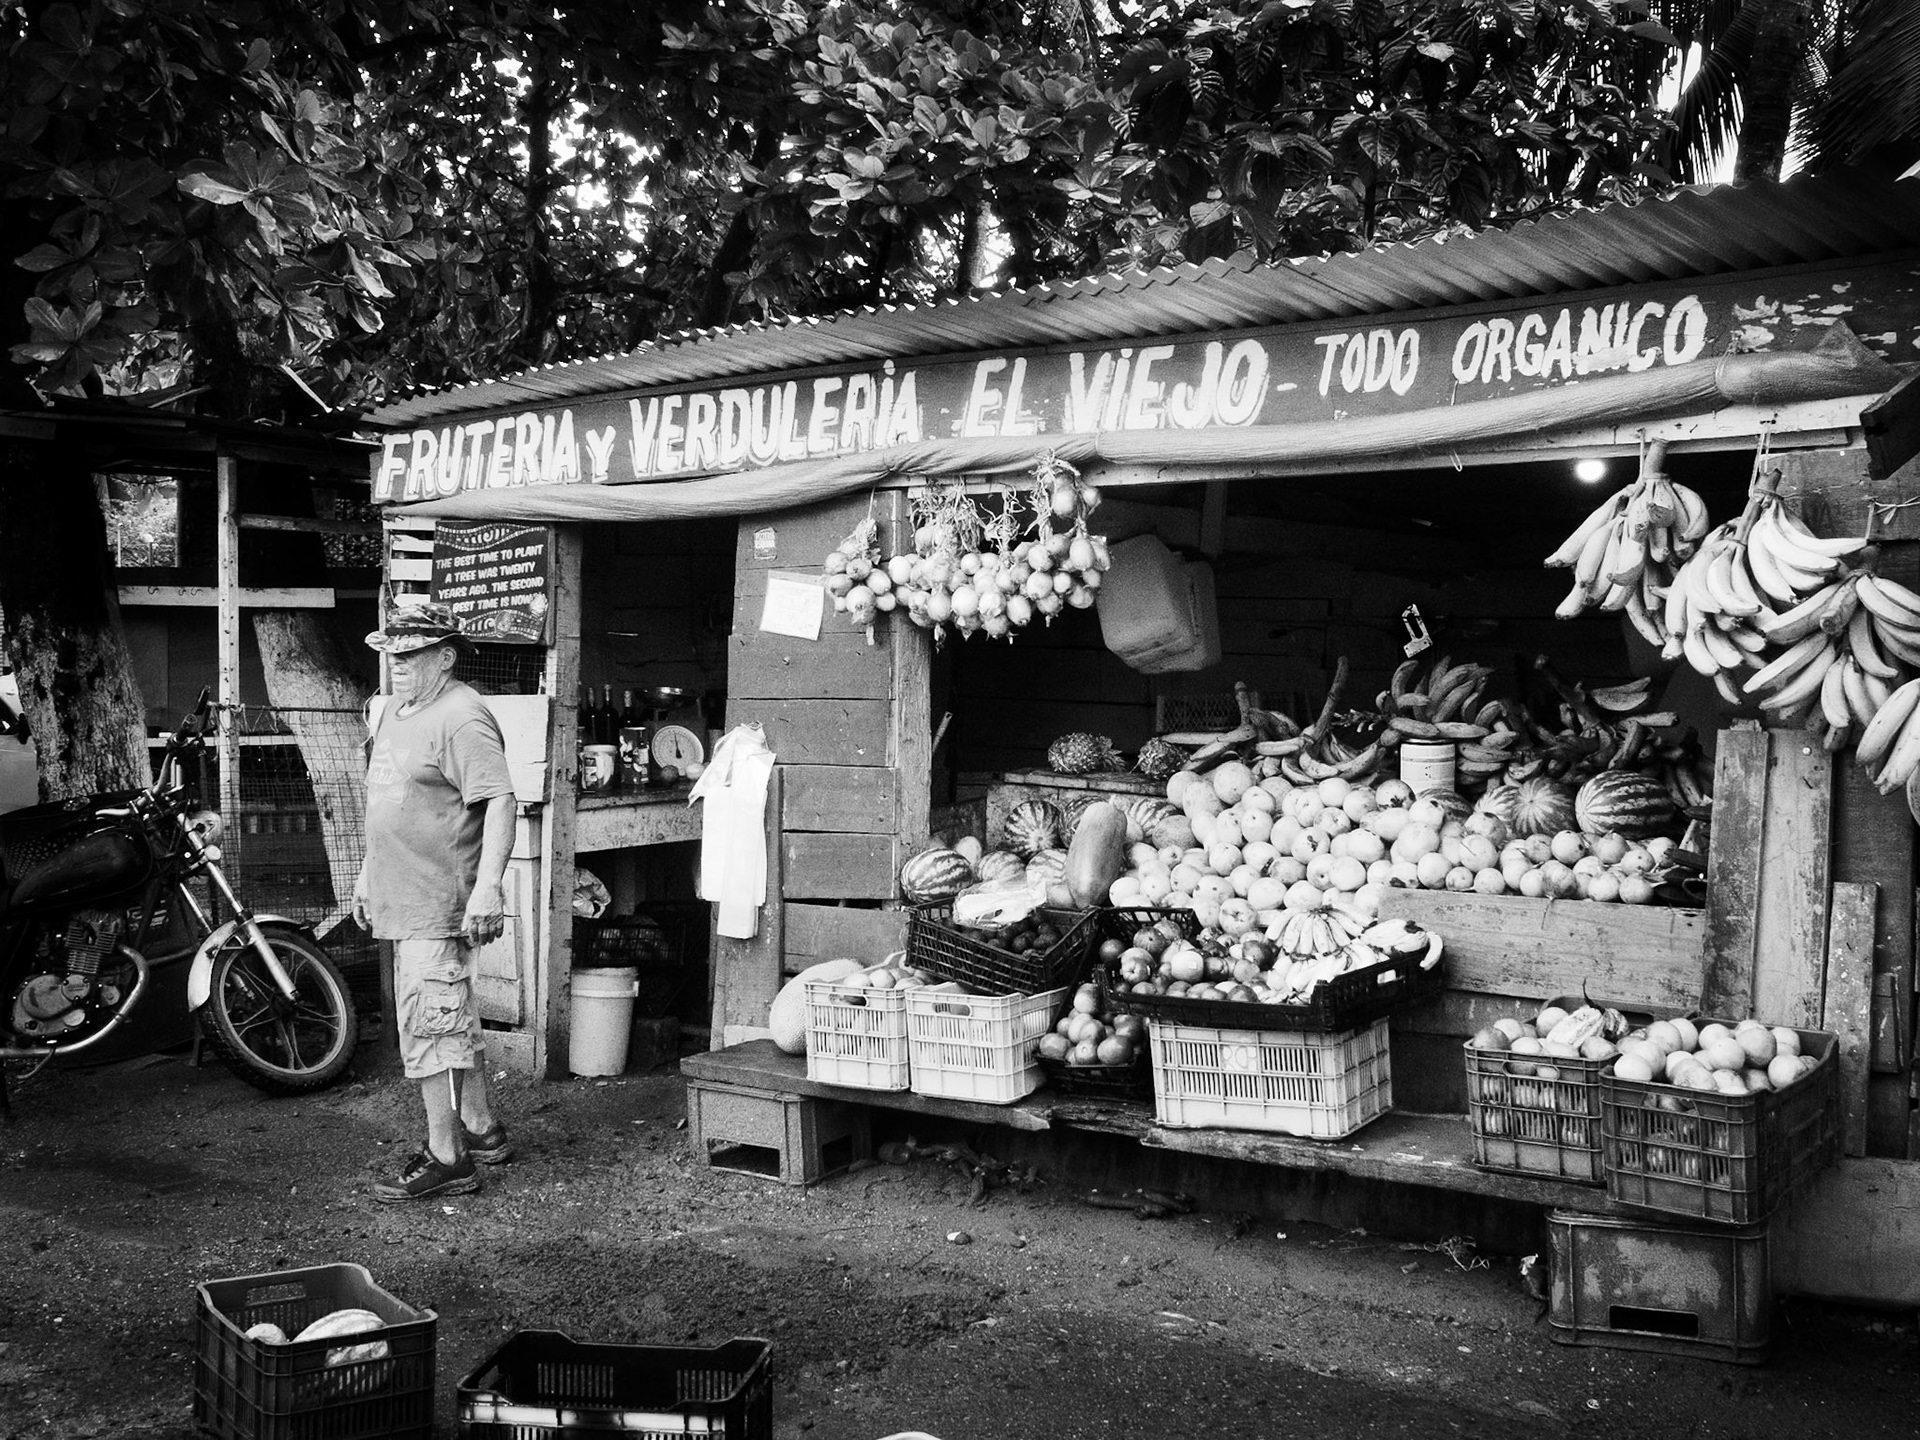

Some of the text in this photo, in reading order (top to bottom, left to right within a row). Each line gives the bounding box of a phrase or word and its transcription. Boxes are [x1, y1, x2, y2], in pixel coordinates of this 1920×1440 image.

[375, 408, 582, 500] FRUTERIA
[585, 425, 617, 484] Y
[960, 356, 1039, 438] EL
[1314, 328, 1420, 396] TODO
[1451, 294, 1709, 385] ORGANICO
[436, 545, 544, 569] THE BEST TIME TO PLANT
[445, 562, 536, 584] A TREE WAS TWENTY
[438, 587, 467, 600] YEARS
[491, 581, 509, 593] THE
[509, 577, 545, 591] SECOND
[452, 601, 475, 613] BEST
[477, 597, 499, 610] TIME
[500, 596, 510, 607] IS
